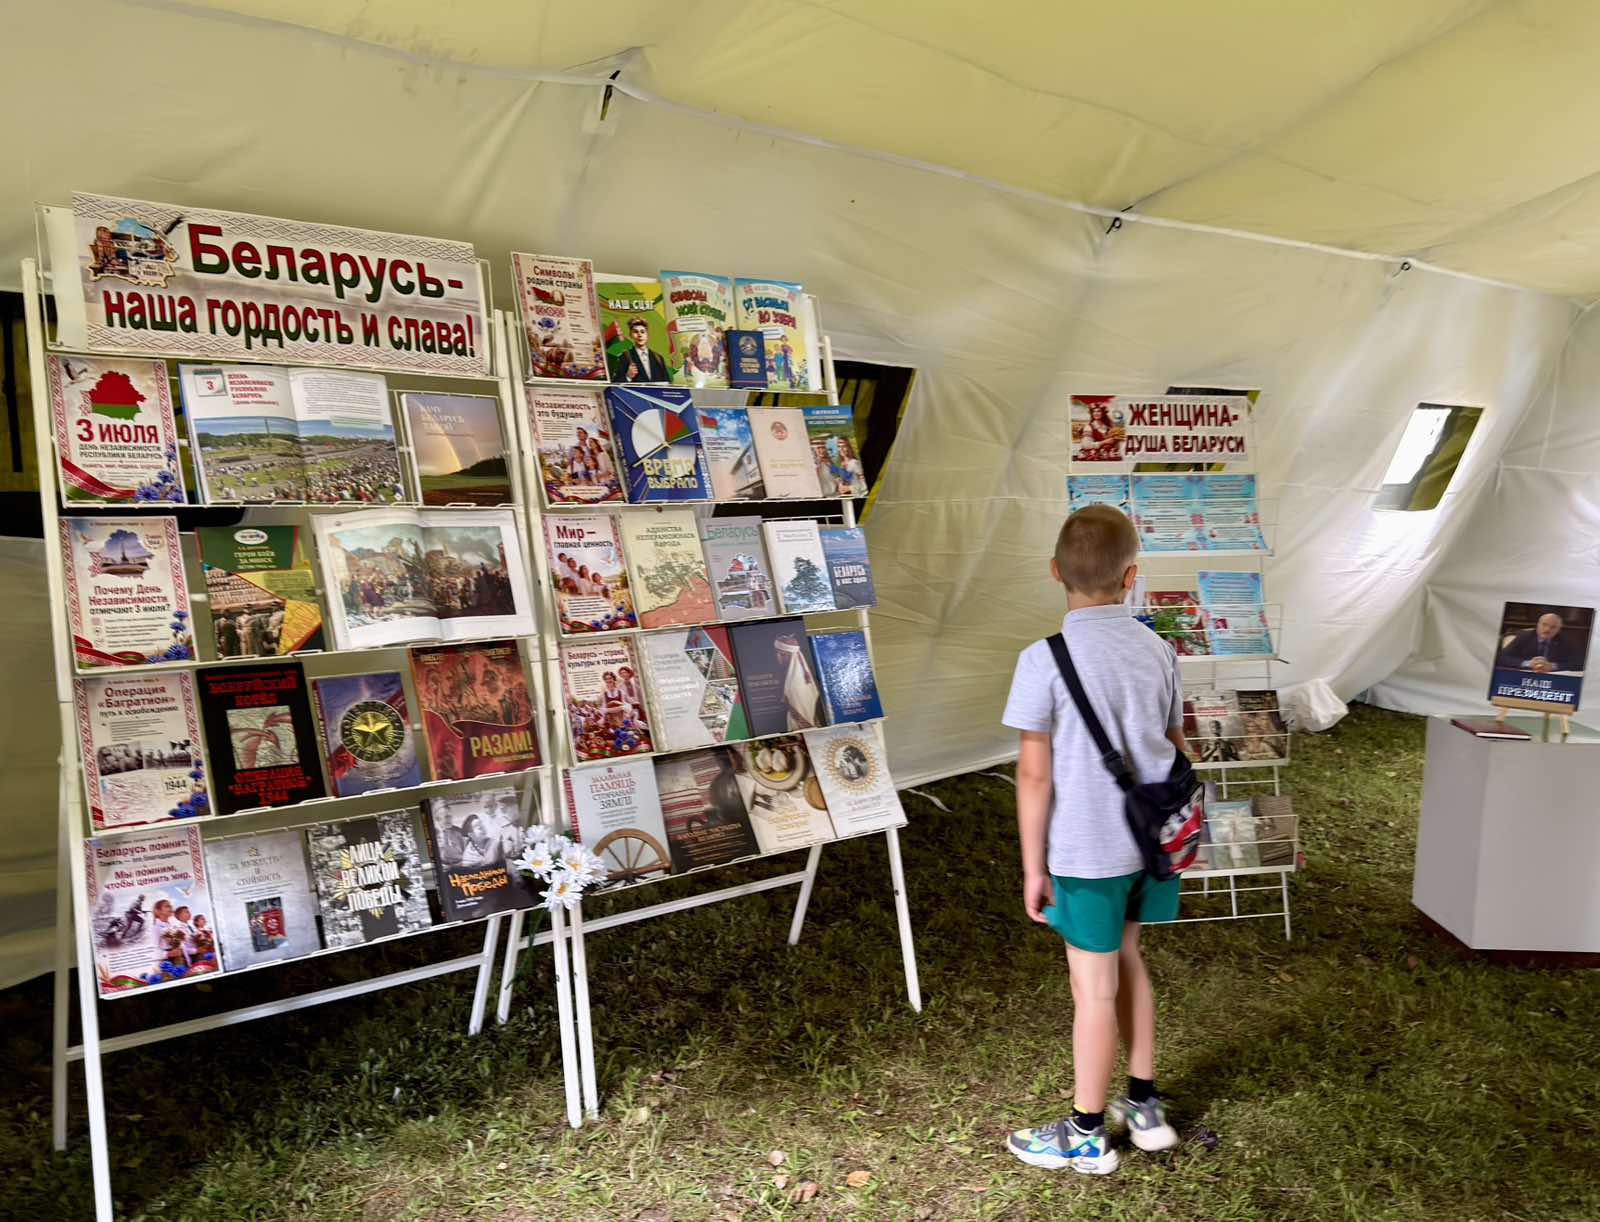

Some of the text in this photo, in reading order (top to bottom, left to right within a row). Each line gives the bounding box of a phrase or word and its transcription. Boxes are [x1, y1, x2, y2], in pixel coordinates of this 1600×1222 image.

[188, 223, 464, 303] Беларусь-
[533, 265, 576, 280] Символы
[526, 276, 583, 290] родной страны
[607, 298, 630, 310] НАШ
[103, 290, 476, 358] наша гордость и слава!
[1128, 403, 1239, 430] ЖЕНЩИНА-
[76, 418, 159, 444] 3 ИЮЛЯ
[1125, 435, 1245, 456] ДУША БЕЛАРУСИ
[556, 525, 584, 541] Мир
[94, 584, 162, 596] Почему День
[88, 595, 168, 607] Независимости
[89, 606, 133, 615] отмечают
[104, 686, 166, 697] Операция
[97, 697, 176, 708] «Багратион»
[470, 731, 534, 758] РАЗАМ!
[96, 847, 146, 858] Беларусь
[114, 870, 132, 879] Мы
[104, 881, 134, 890] чтобы
[137, 876, 169, 886] ценить
